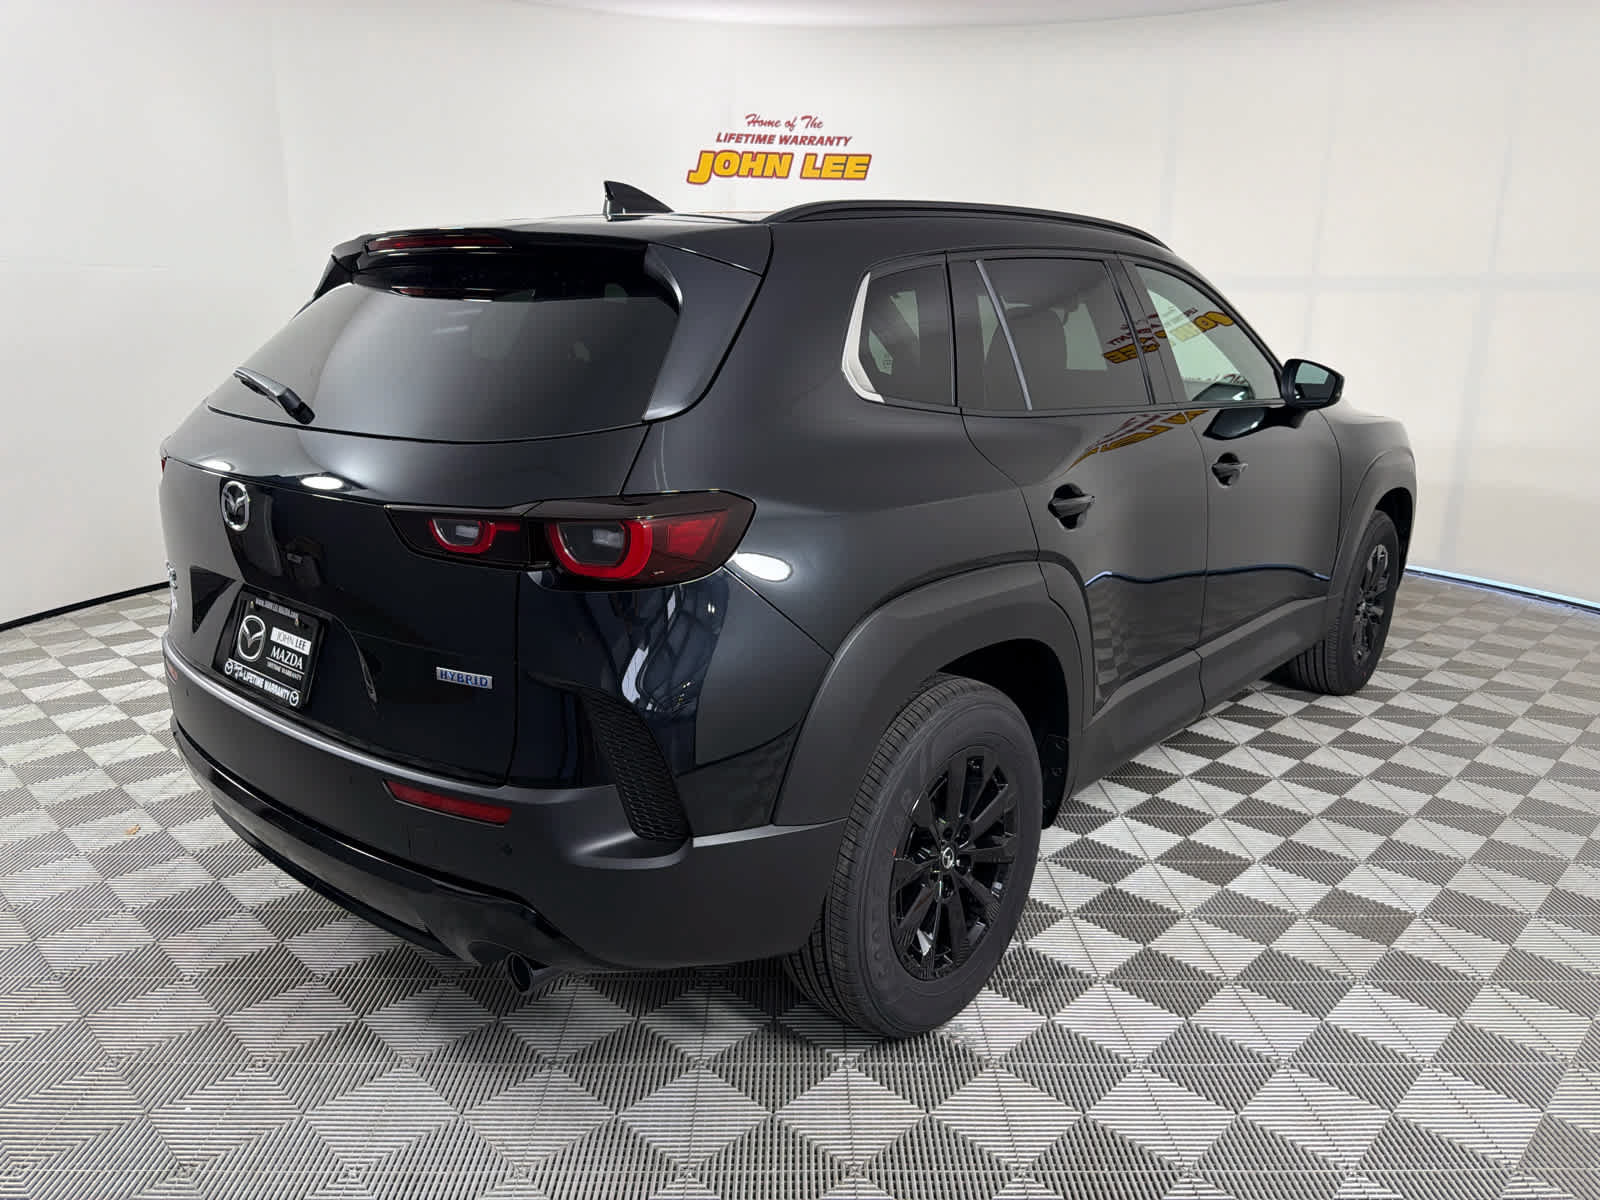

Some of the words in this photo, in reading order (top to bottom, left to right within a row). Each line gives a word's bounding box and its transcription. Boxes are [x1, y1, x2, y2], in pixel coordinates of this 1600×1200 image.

[745, 113, 782, 128] Home
[784, 116, 798, 132] of
[801, 115, 823, 129] The
[715, 132, 776, 145] LIFETIME
[778, 134, 852, 147] WARRANTY
[687, 150, 794, 185] JOHN
[800, 153, 872, 181] LEE
[275, 631, 295, 646] JOHN
[295, 637, 306, 650] LEE
[270, 645, 303, 670] MAZDA
[242, 671, 265, 689] LIFETIME
[264, 679, 290, 700] WARRANTY
[440, 670, 489, 688] HYBRID
